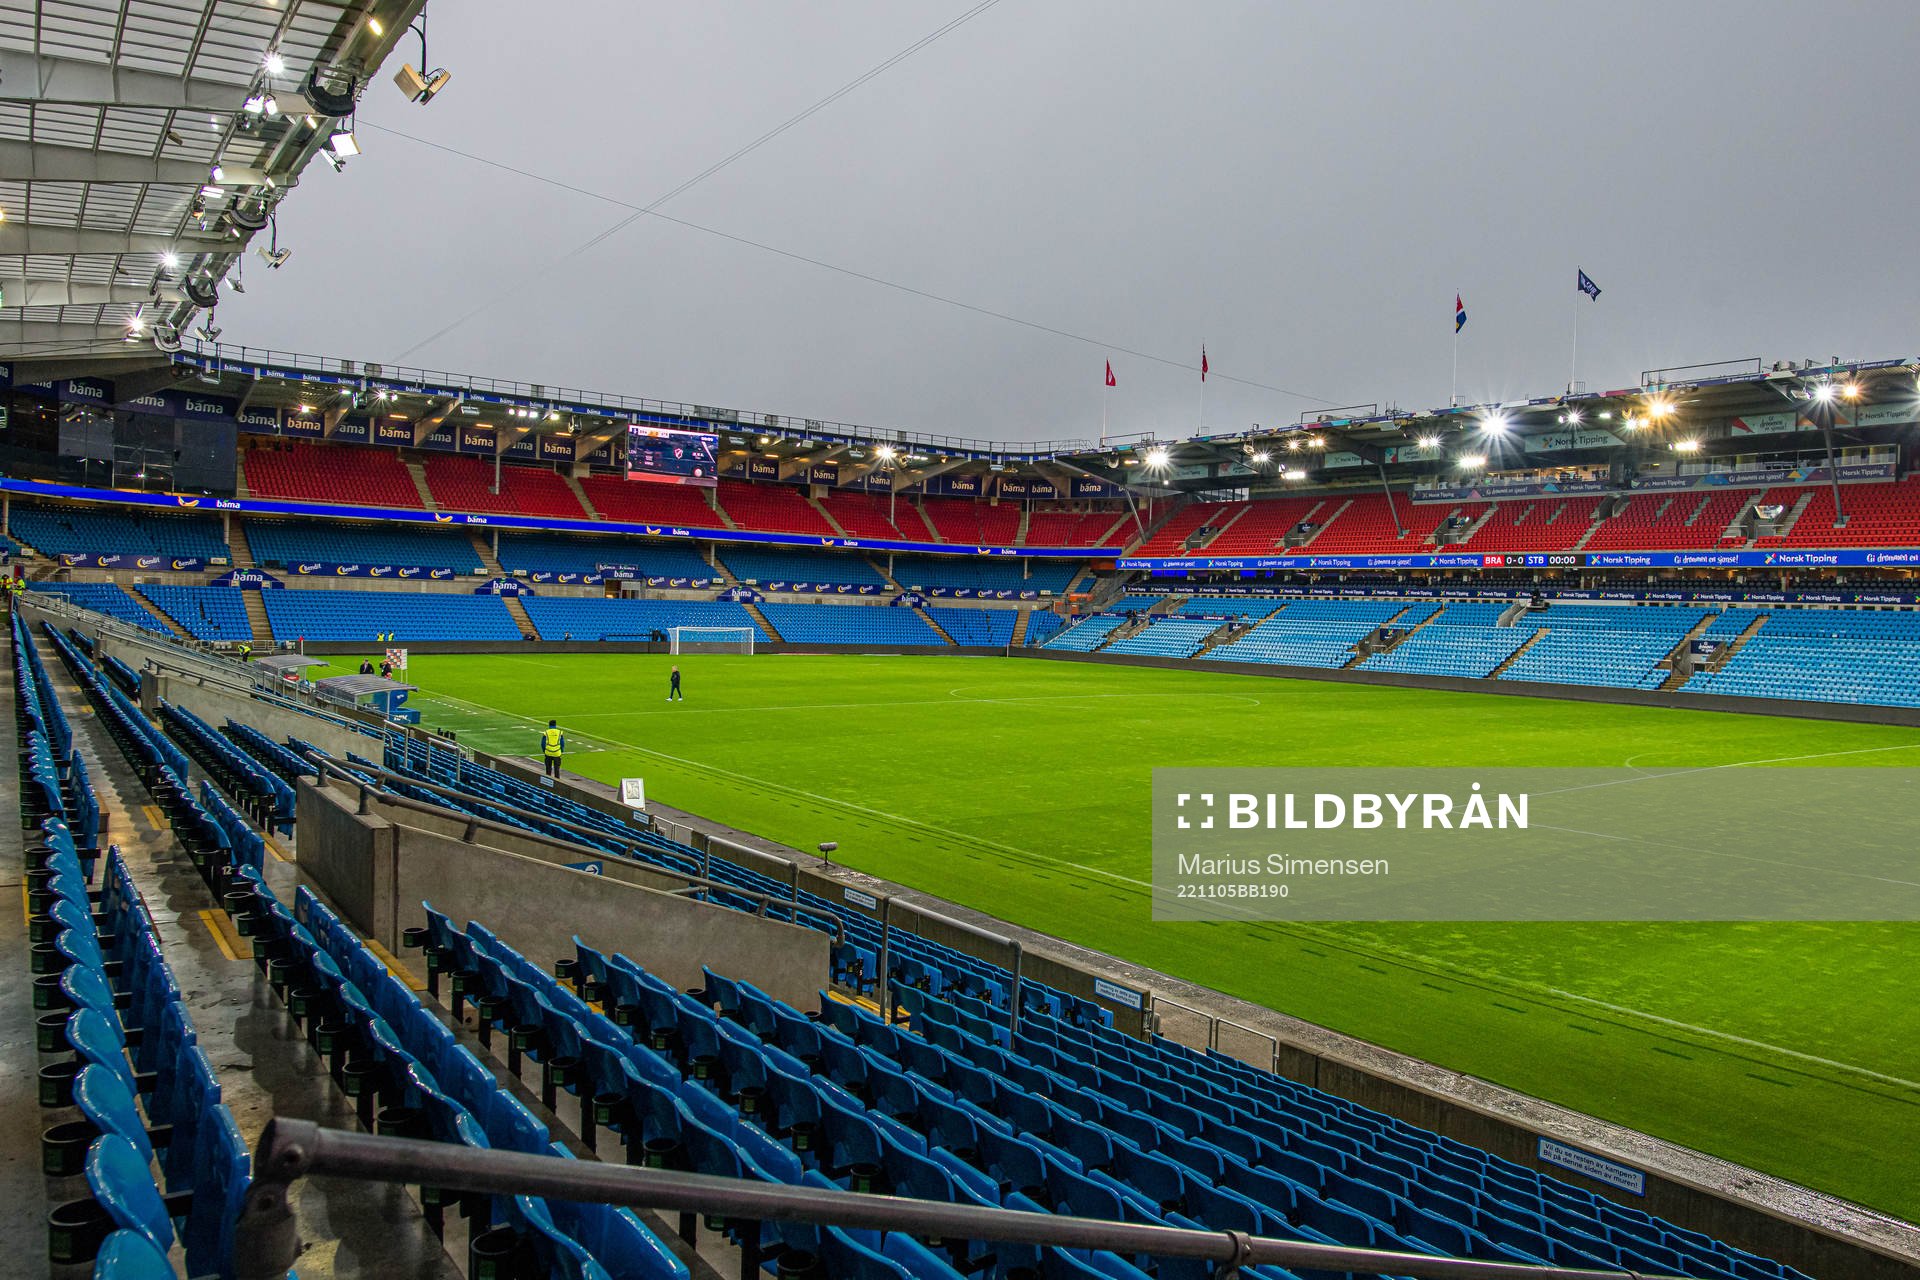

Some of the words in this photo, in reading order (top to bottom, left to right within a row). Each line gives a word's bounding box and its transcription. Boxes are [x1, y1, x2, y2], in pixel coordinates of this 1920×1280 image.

[69, 381, 103, 398] bama
[129, 395, 165, 407] ama
[186, 398, 223, 414] bama
[1886, 410, 1911, 418] Tipping
[288, 417, 321, 430] bama
[339, 423, 365, 434] ama
[379, 426, 411, 439] bama
[429, 433, 452, 443] ama
[465, 435, 494, 447] bama
[1579, 435, 1608, 444] Tipping
[544, 443, 571, 455] bama
[753, 464, 775, 474] bama
[1862, 468, 1884, 476] Tipping
[814, 470, 834, 480] bama
[871, 475, 890, 485] bama
[952, 481, 974, 490] bama
[1003, 483, 1024, 493] bama
[1032, 484, 1052, 493] bama
[1080, 483, 1101, 492] bama
[217, 499, 240, 508] bama
[467, 516, 487, 524] bama
[673, 528, 690, 536] bama
[1333, 559, 1350, 567] Tipping
[1456, 557, 1478, 566] Tipping
[1528, 556, 1544, 564] STB
[1550, 556, 1575, 564] 00:00
[1624, 556, 1651, 565] Tipping
[1779, 554, 1803, 563] Norsk
[1804, 554, 1838, 564] Tipping
[233, 571, 263, 582] bama
[614, 570, 634, 578] bama
[493, 580, 517, 590] bama
[732, 589, 752, 597] bama
[1880, 595, 1901, 603] Tipping
[222, 866, 232, 875] 12
[1543, 1149, 1552, 1157] Bli
[1553, 1154, 1562, 1163] på
[1562, 1156, 1583, 1169] denne
[1584, 1163, 1603, 1176] siden
[1604, 1171, 1612, 1179] av
[1613, 1175, 1638, 1188] muren!
[1574, 1154, 1595, 1165] resten
[1596, 1161, 1604, 1169] av
[1605, 1164, 1637, 1180] kampen?
